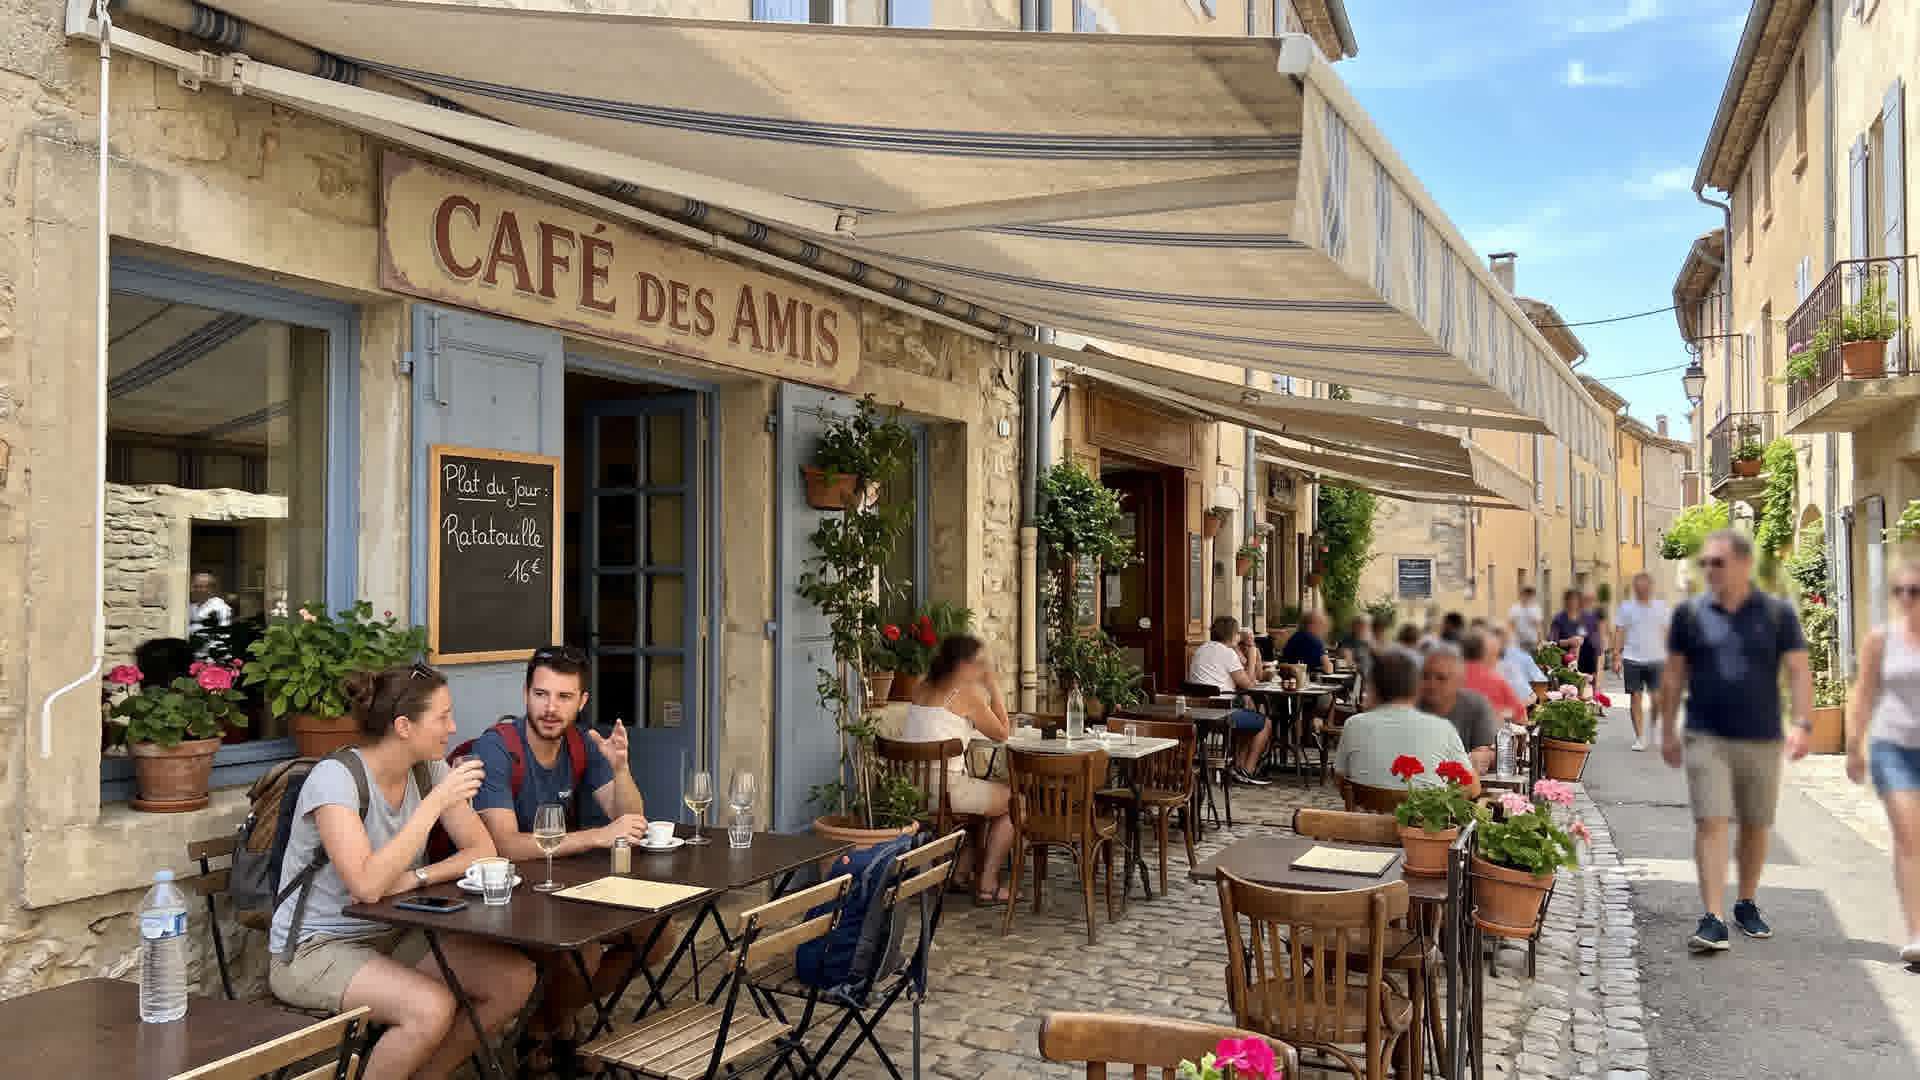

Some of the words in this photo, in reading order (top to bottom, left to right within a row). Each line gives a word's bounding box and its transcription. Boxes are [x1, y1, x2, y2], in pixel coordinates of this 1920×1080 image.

[434, 194, 617, 314] CAFÉ
[636, 271, 716, 338] DES
[728, 284, 841, 368] AMIS
[443, 464, 480, 493] Plat
[486, 472, 506, 495] du
[442, 513, 544, 552] Ratatouille
[507, 558, 542, 584] 16€
